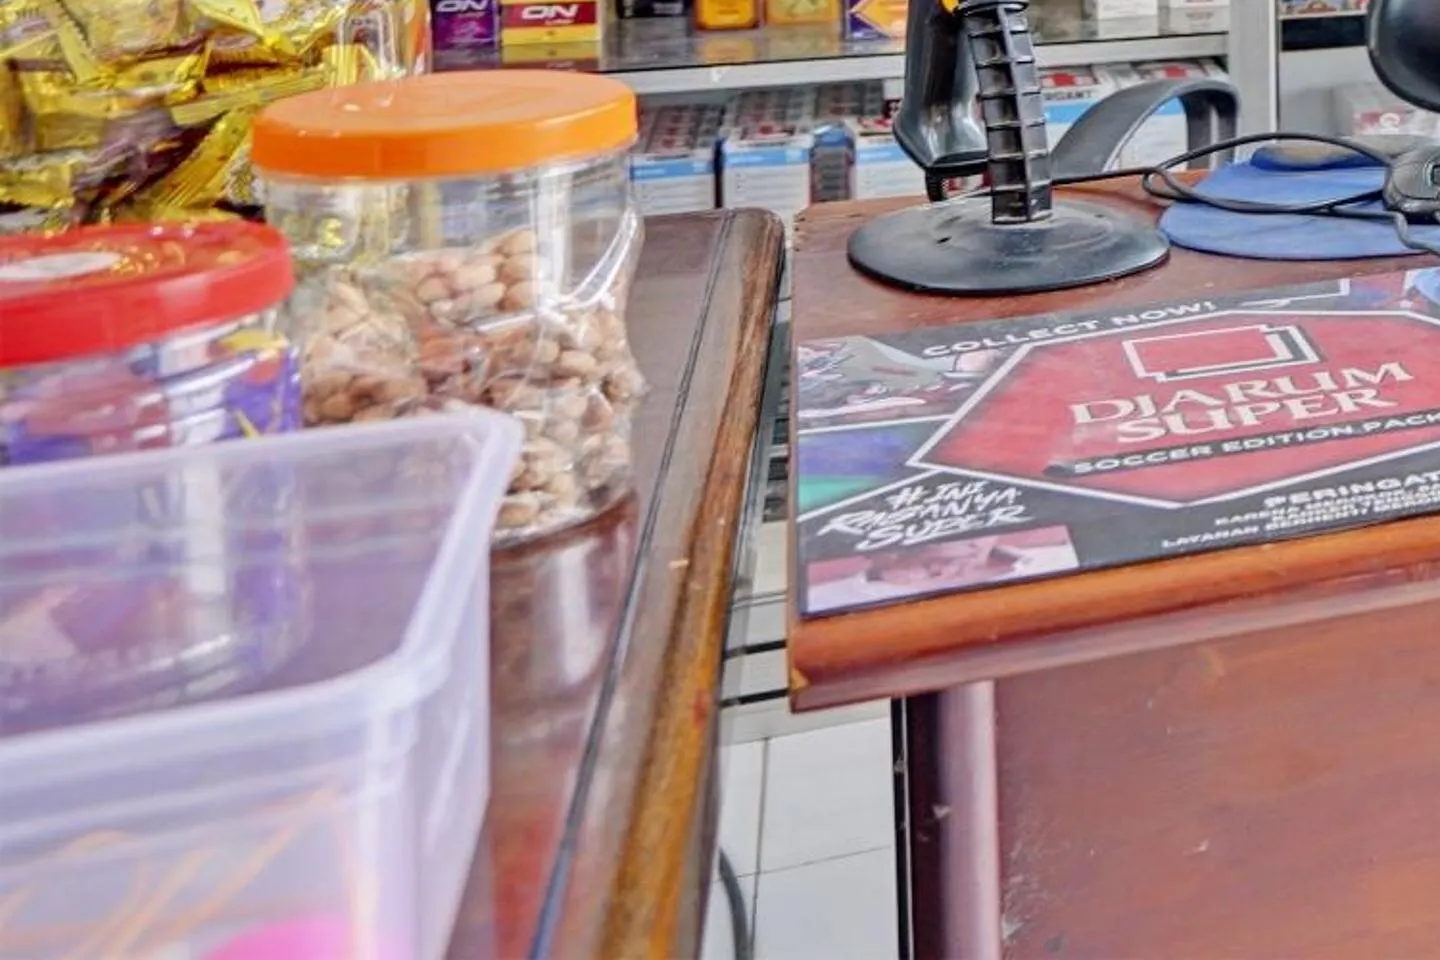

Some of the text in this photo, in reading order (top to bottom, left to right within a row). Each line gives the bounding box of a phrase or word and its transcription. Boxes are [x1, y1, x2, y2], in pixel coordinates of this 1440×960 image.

[521, 4, 579, 20] ON
[922, 299, 1218, 358] COLLECT NOW!
[1068, 361, 1415, 425] DJARUM
[1115, 387, 1400, 444] SUPER
[1072, 443, 1214, 474] SOCCER
[1221, 423, 1353, 453] EDITION
[855, 504, 1037, 551] SUPER
[1161, 524, 1259, 548] LAYANAN
